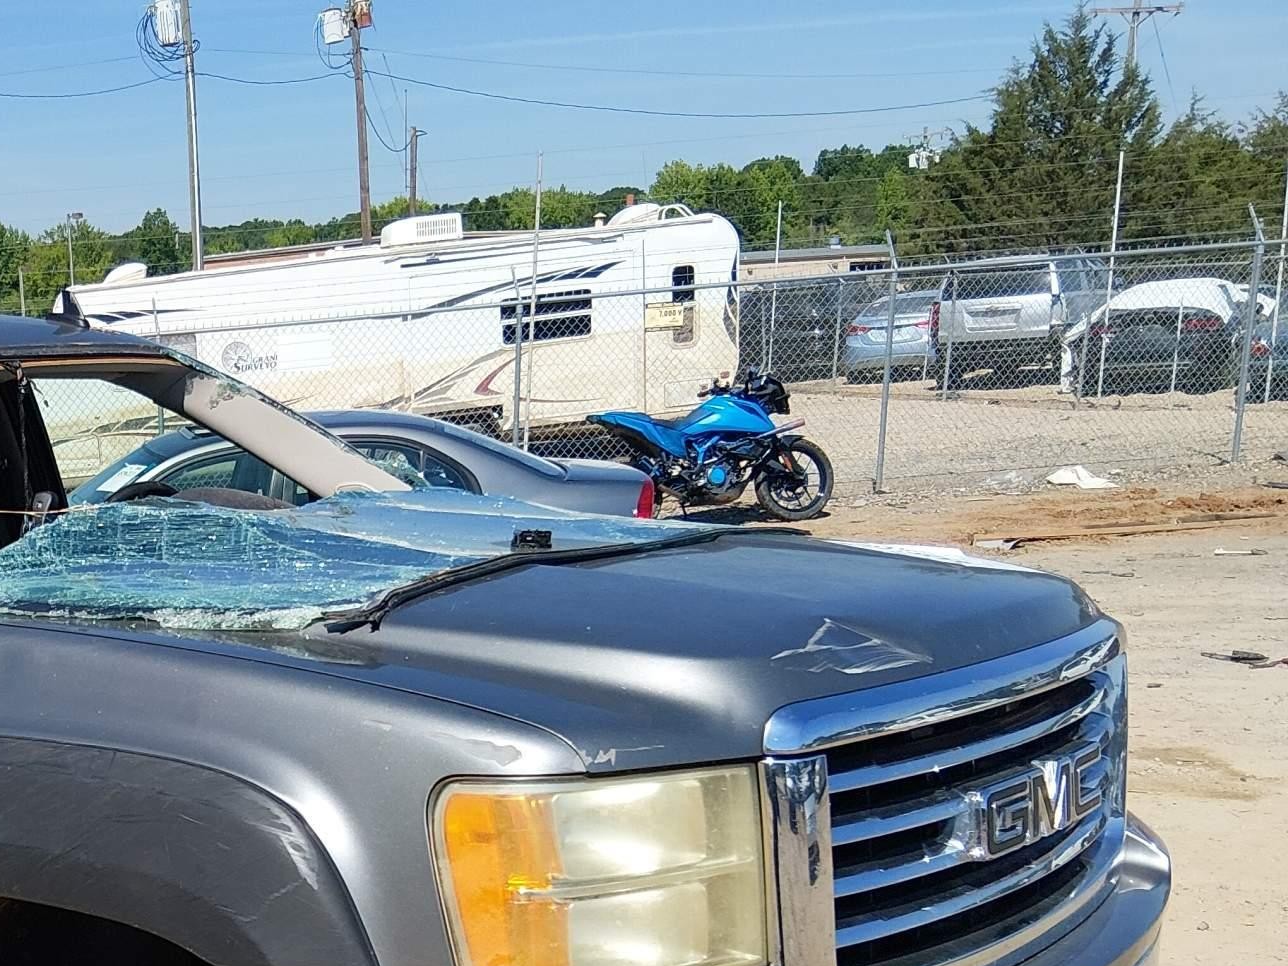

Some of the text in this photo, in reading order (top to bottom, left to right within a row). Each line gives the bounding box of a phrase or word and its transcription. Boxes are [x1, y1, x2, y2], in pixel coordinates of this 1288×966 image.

[252, 353, 277, 364] GRAN
[233, 359, 277, 372] SURVEYO
[986, 742, 1105, 857] GMC
